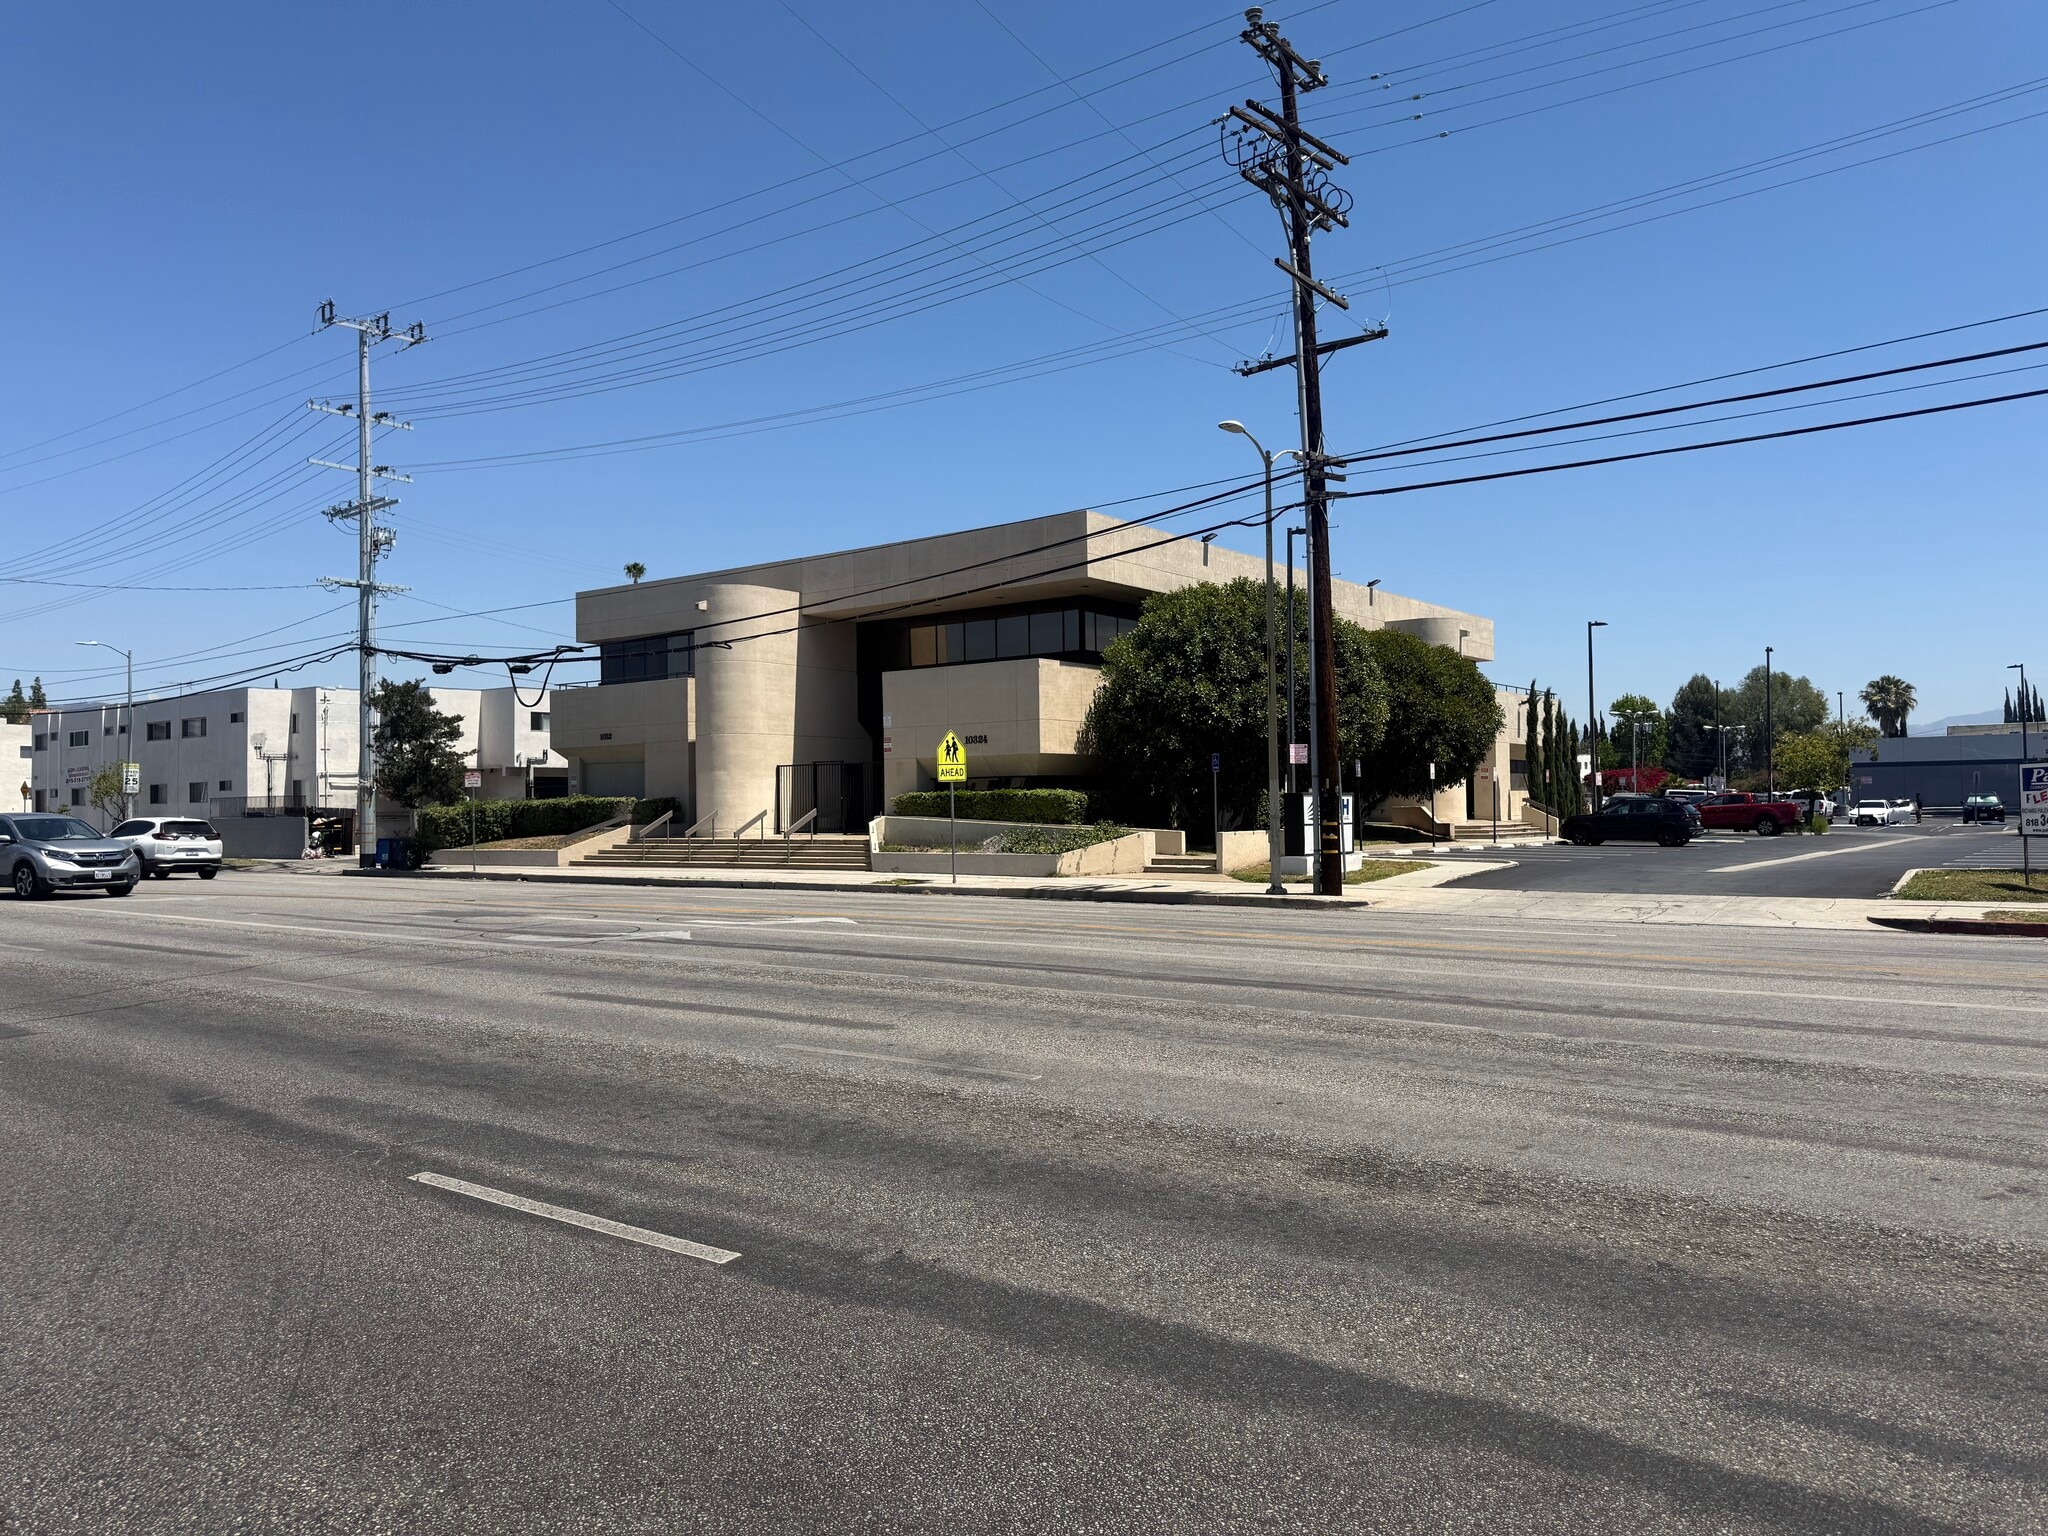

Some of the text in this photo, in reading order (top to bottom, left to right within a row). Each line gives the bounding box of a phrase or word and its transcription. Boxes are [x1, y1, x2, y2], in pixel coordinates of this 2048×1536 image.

[965, 735, 988, 744] 10324
[940, 768, 964, 777] AHEAD
[2026, 813, 2048, 827] 818 3
